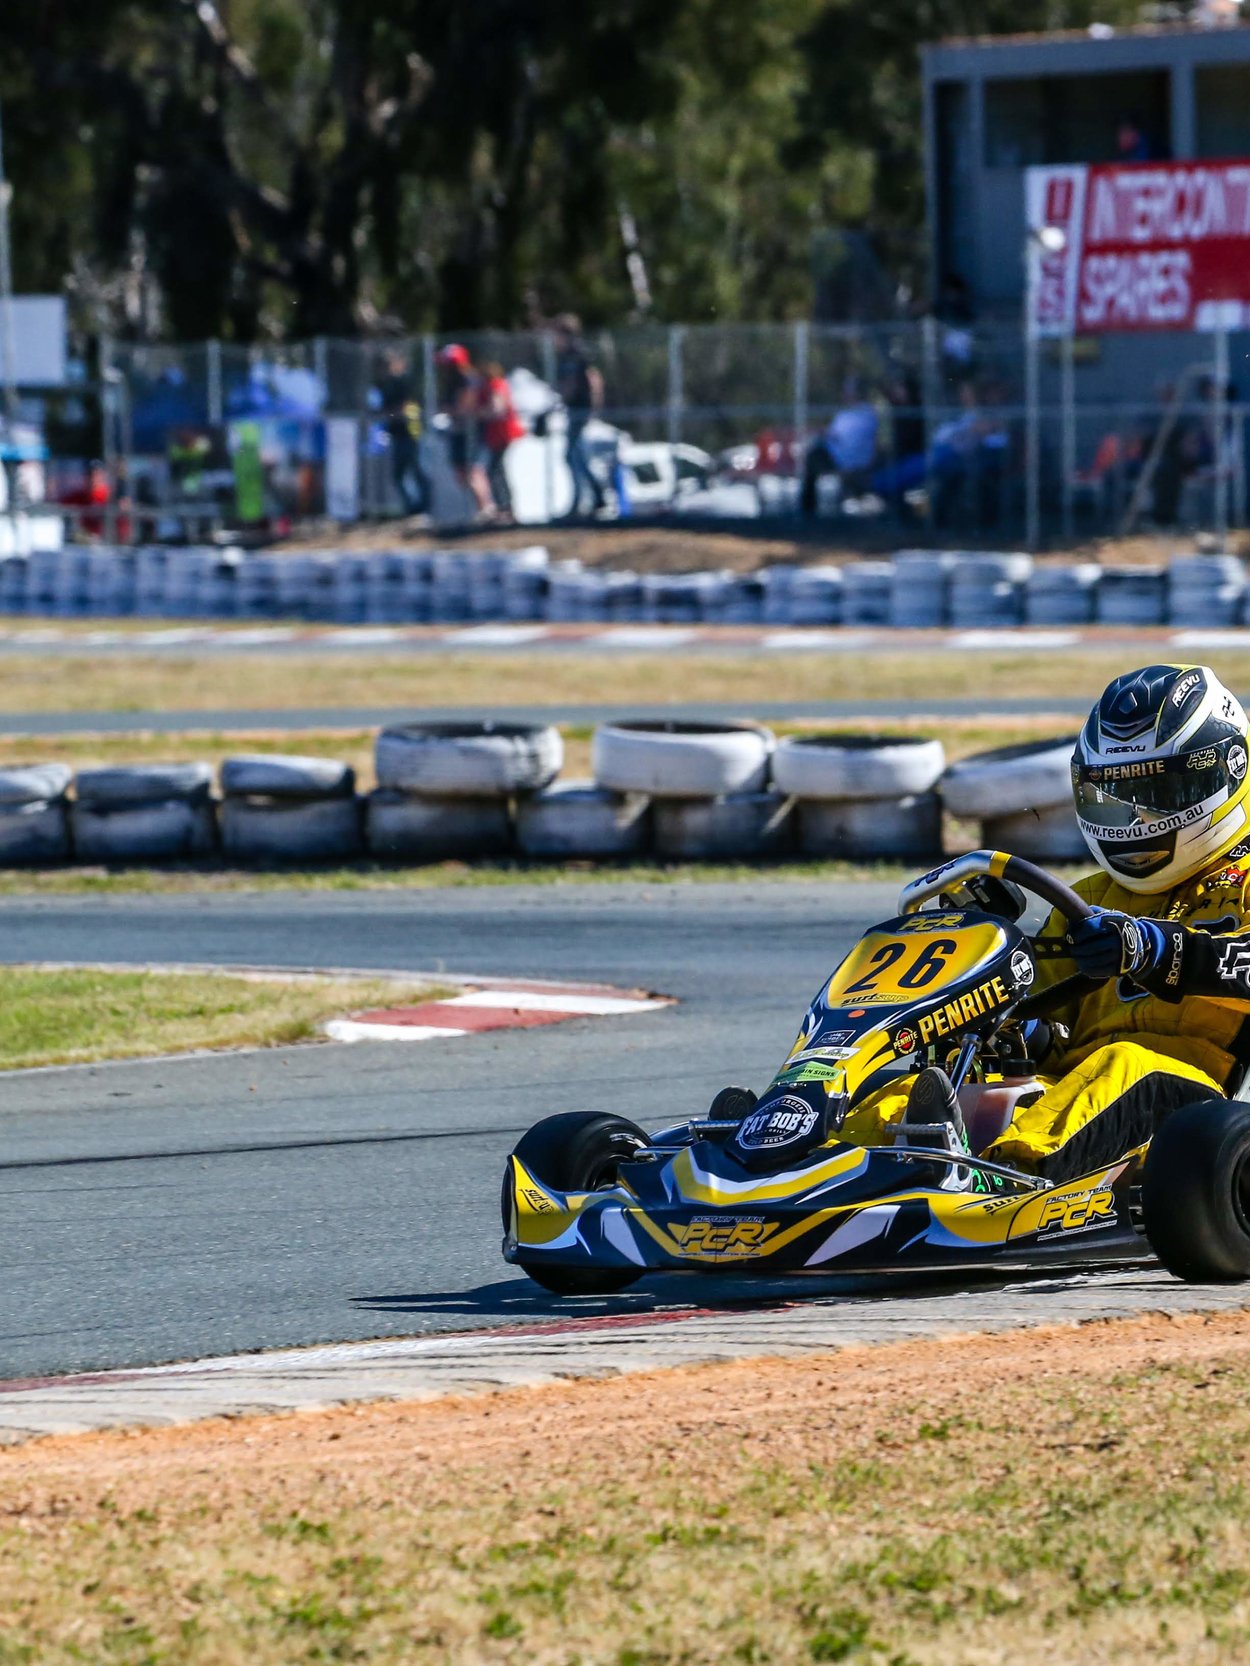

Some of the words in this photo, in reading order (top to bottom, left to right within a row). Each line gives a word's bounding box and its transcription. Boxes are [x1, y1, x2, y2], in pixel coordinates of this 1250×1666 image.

[1172, 673, 1200, 708] REEVU
[1105, 745, 1146, 755] REEVU
[1104, 759, 1166, 781] PENRITE
[1080, 804, 1204, 842] www.reevu.com.au
[898, 914, 964, 933] PCR
[843, 939, 957, 995] 26
[1165, 932, 1183, 986] sparco
[918, 975, 1009, 1044] PENRITE
[893, 1031, 918, 1050] PENRITE
[745, 1113, 770, 1136] FAT
[767, 1112, 818, 1134] BOB'S
[1047, 1190, 1085, 1203] FACTORY
[1087, 1184, 1113, 1195] TEAM
[1038, 1191, 1116, 1230] PCR
[680, 1222, 764, 1251] PCR
